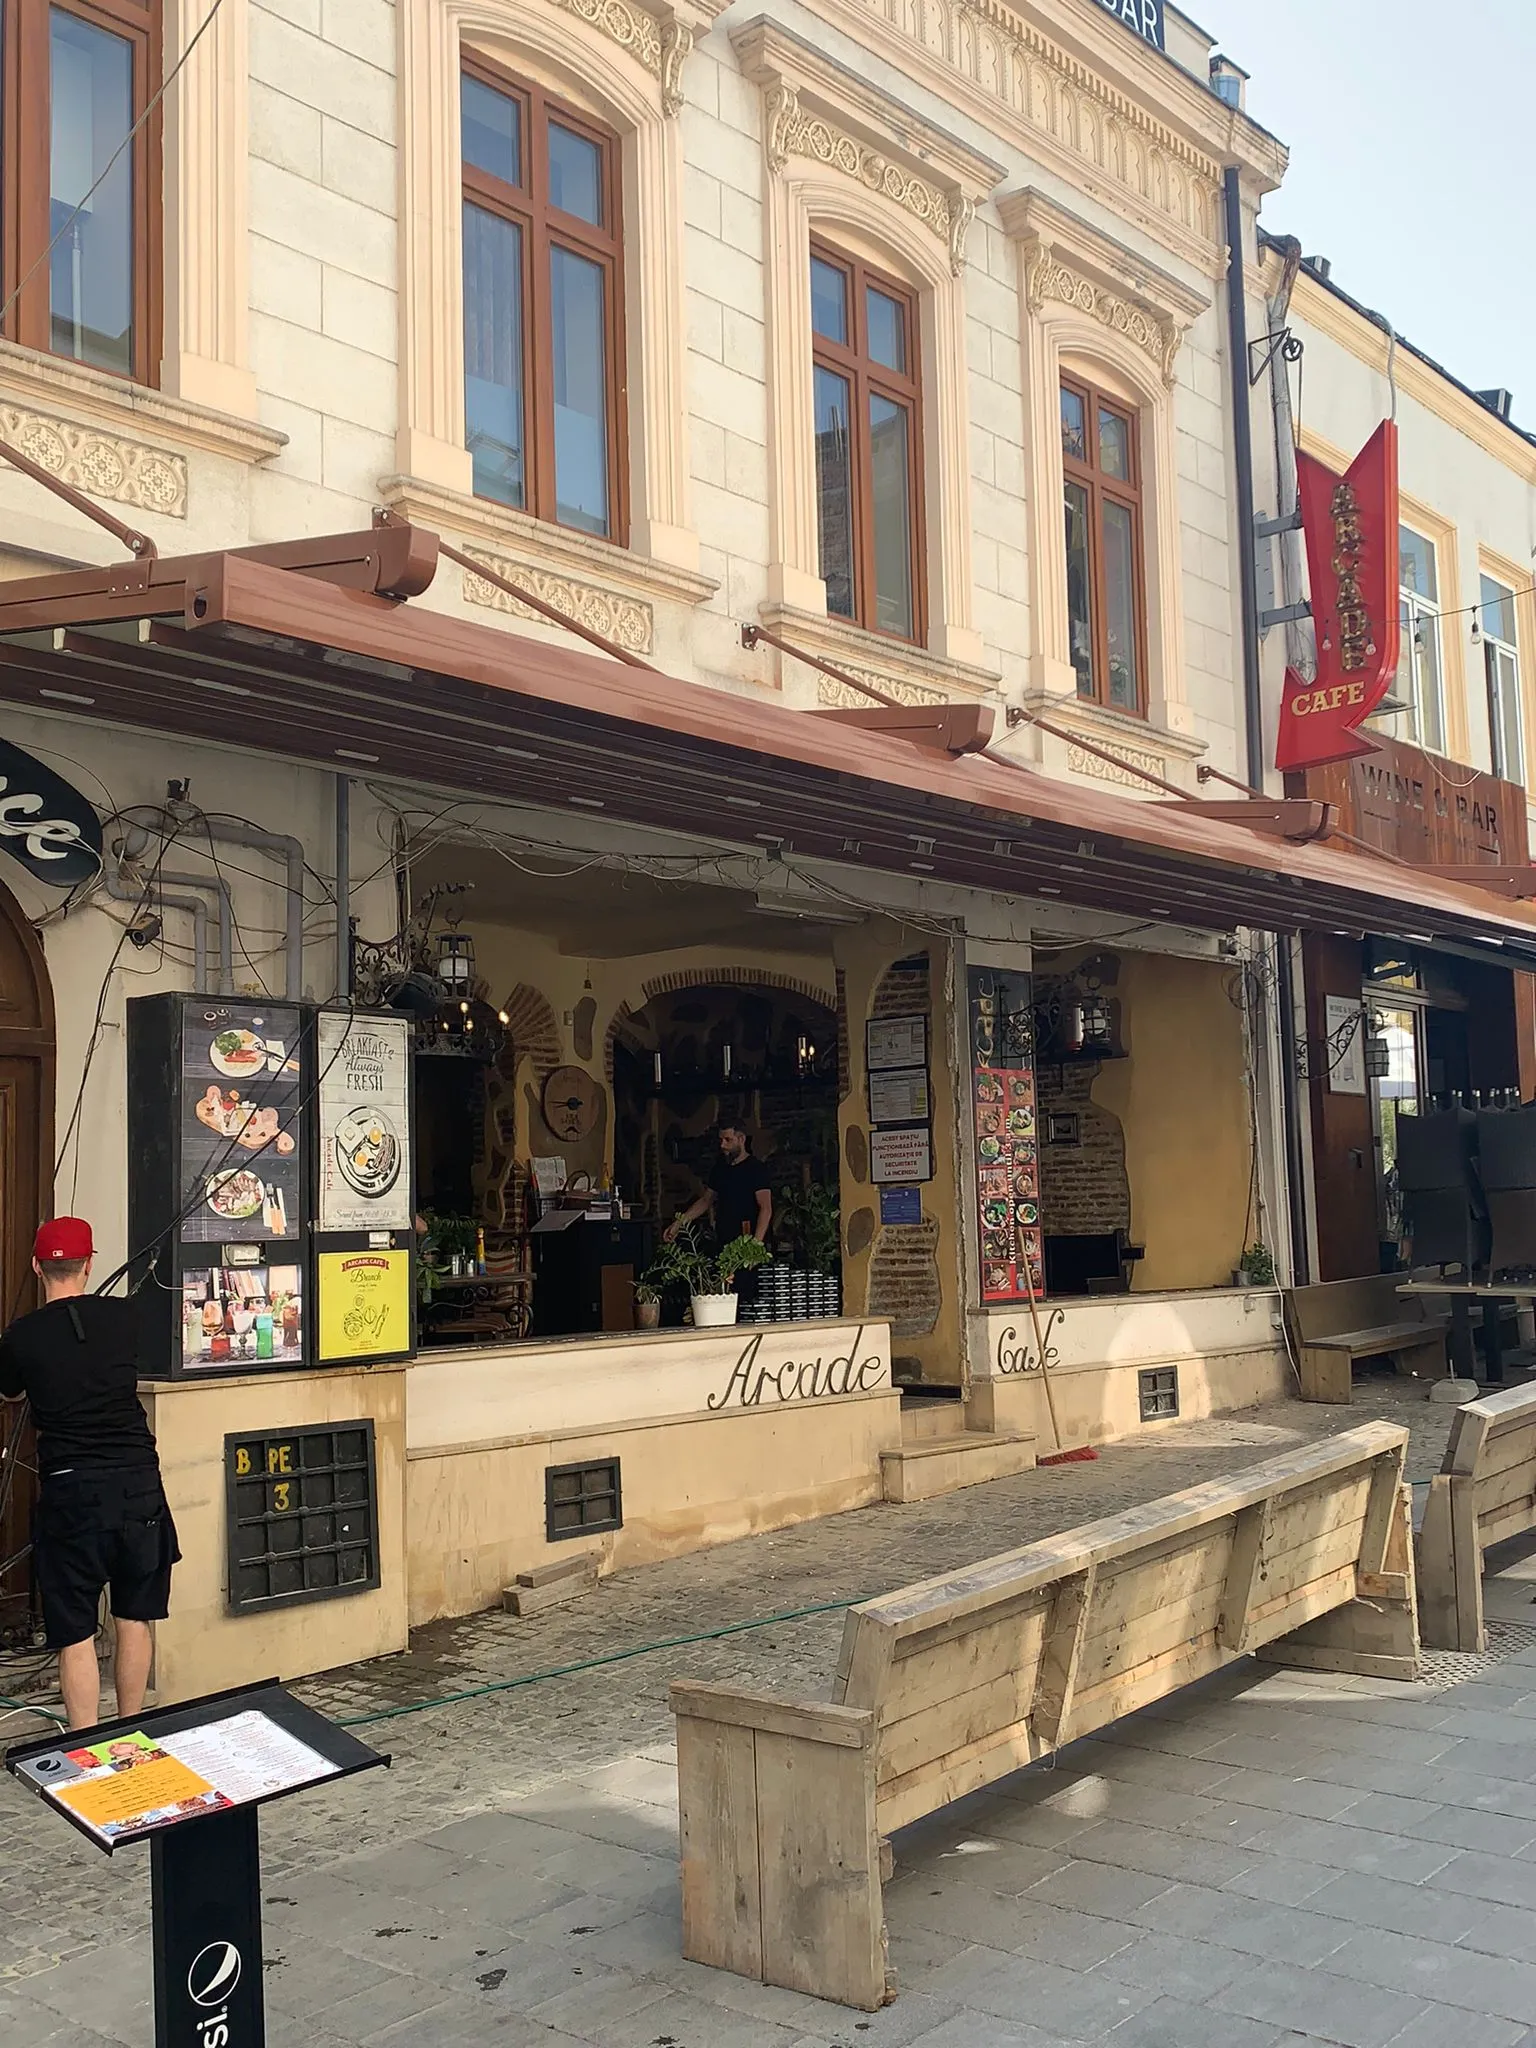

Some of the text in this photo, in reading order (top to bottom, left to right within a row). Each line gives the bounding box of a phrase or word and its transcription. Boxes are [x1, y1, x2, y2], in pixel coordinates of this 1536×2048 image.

[1331, 483, 1366, 671] ARCADE
[1291, 681, 1365, 717] CAFE
[1360, 762, 1424, 811] WINE
[1455, 793, 1498, 834] BAR
[341, 1037, 389, 1059] BREAKFAST
[345, 1057, 384, 1074] Always
[346, 1073, 383, 1091] FRESH
[1005, 1153, 1013, 1181] until
[997, 1308, 1065, 1375] Cafe
[707, 1323, 888, 1411] Arcade
[236, 1446, 292, 1474] B PE
[274, 1482, 289, 1511] 3
